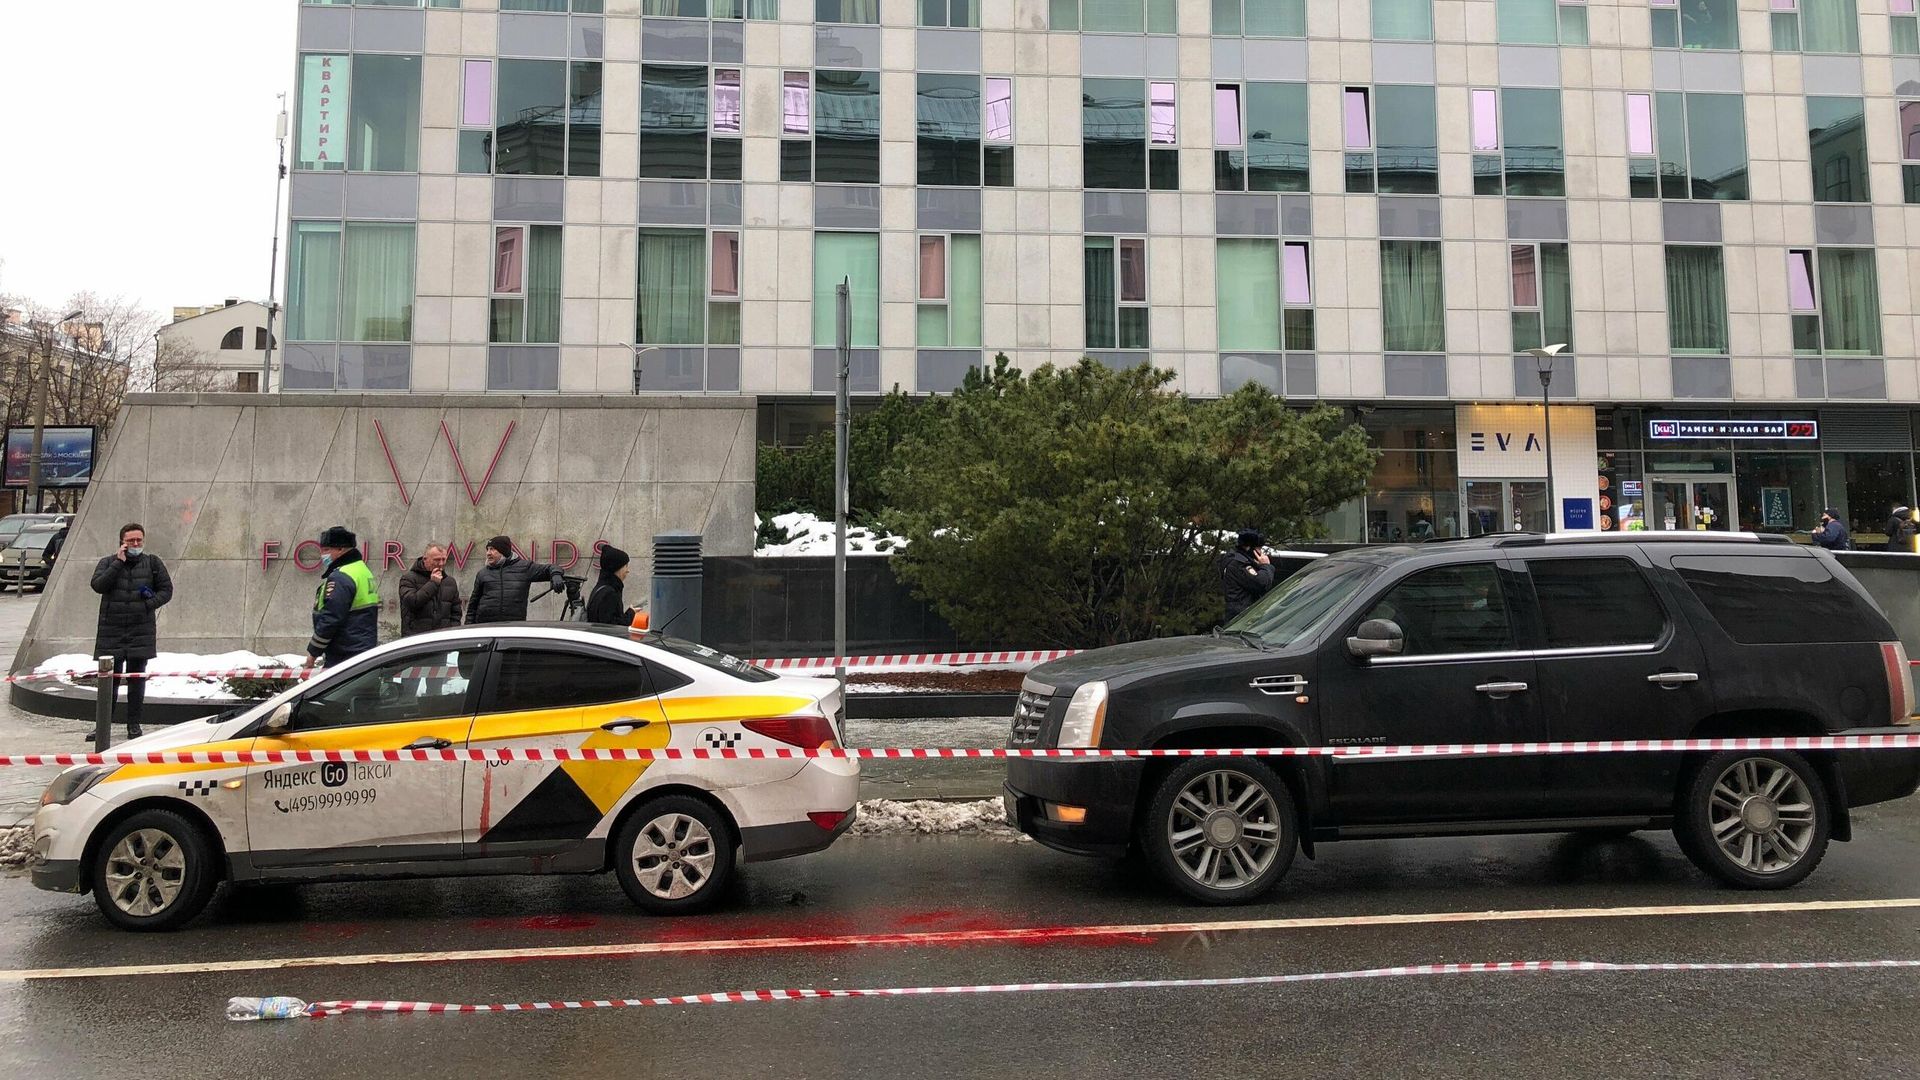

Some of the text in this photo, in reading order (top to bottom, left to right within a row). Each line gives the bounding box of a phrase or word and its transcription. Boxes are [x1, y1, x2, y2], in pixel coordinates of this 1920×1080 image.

[318, 57, 332, 160] КВАРТИРА
[1471, 433, 1541, 451] EVA
[262, 540, 407, 572] FOR
[1329, 736, 1387, 744] ESCALADE
[264, 762, 392, 789] Яндекс Go Такси
